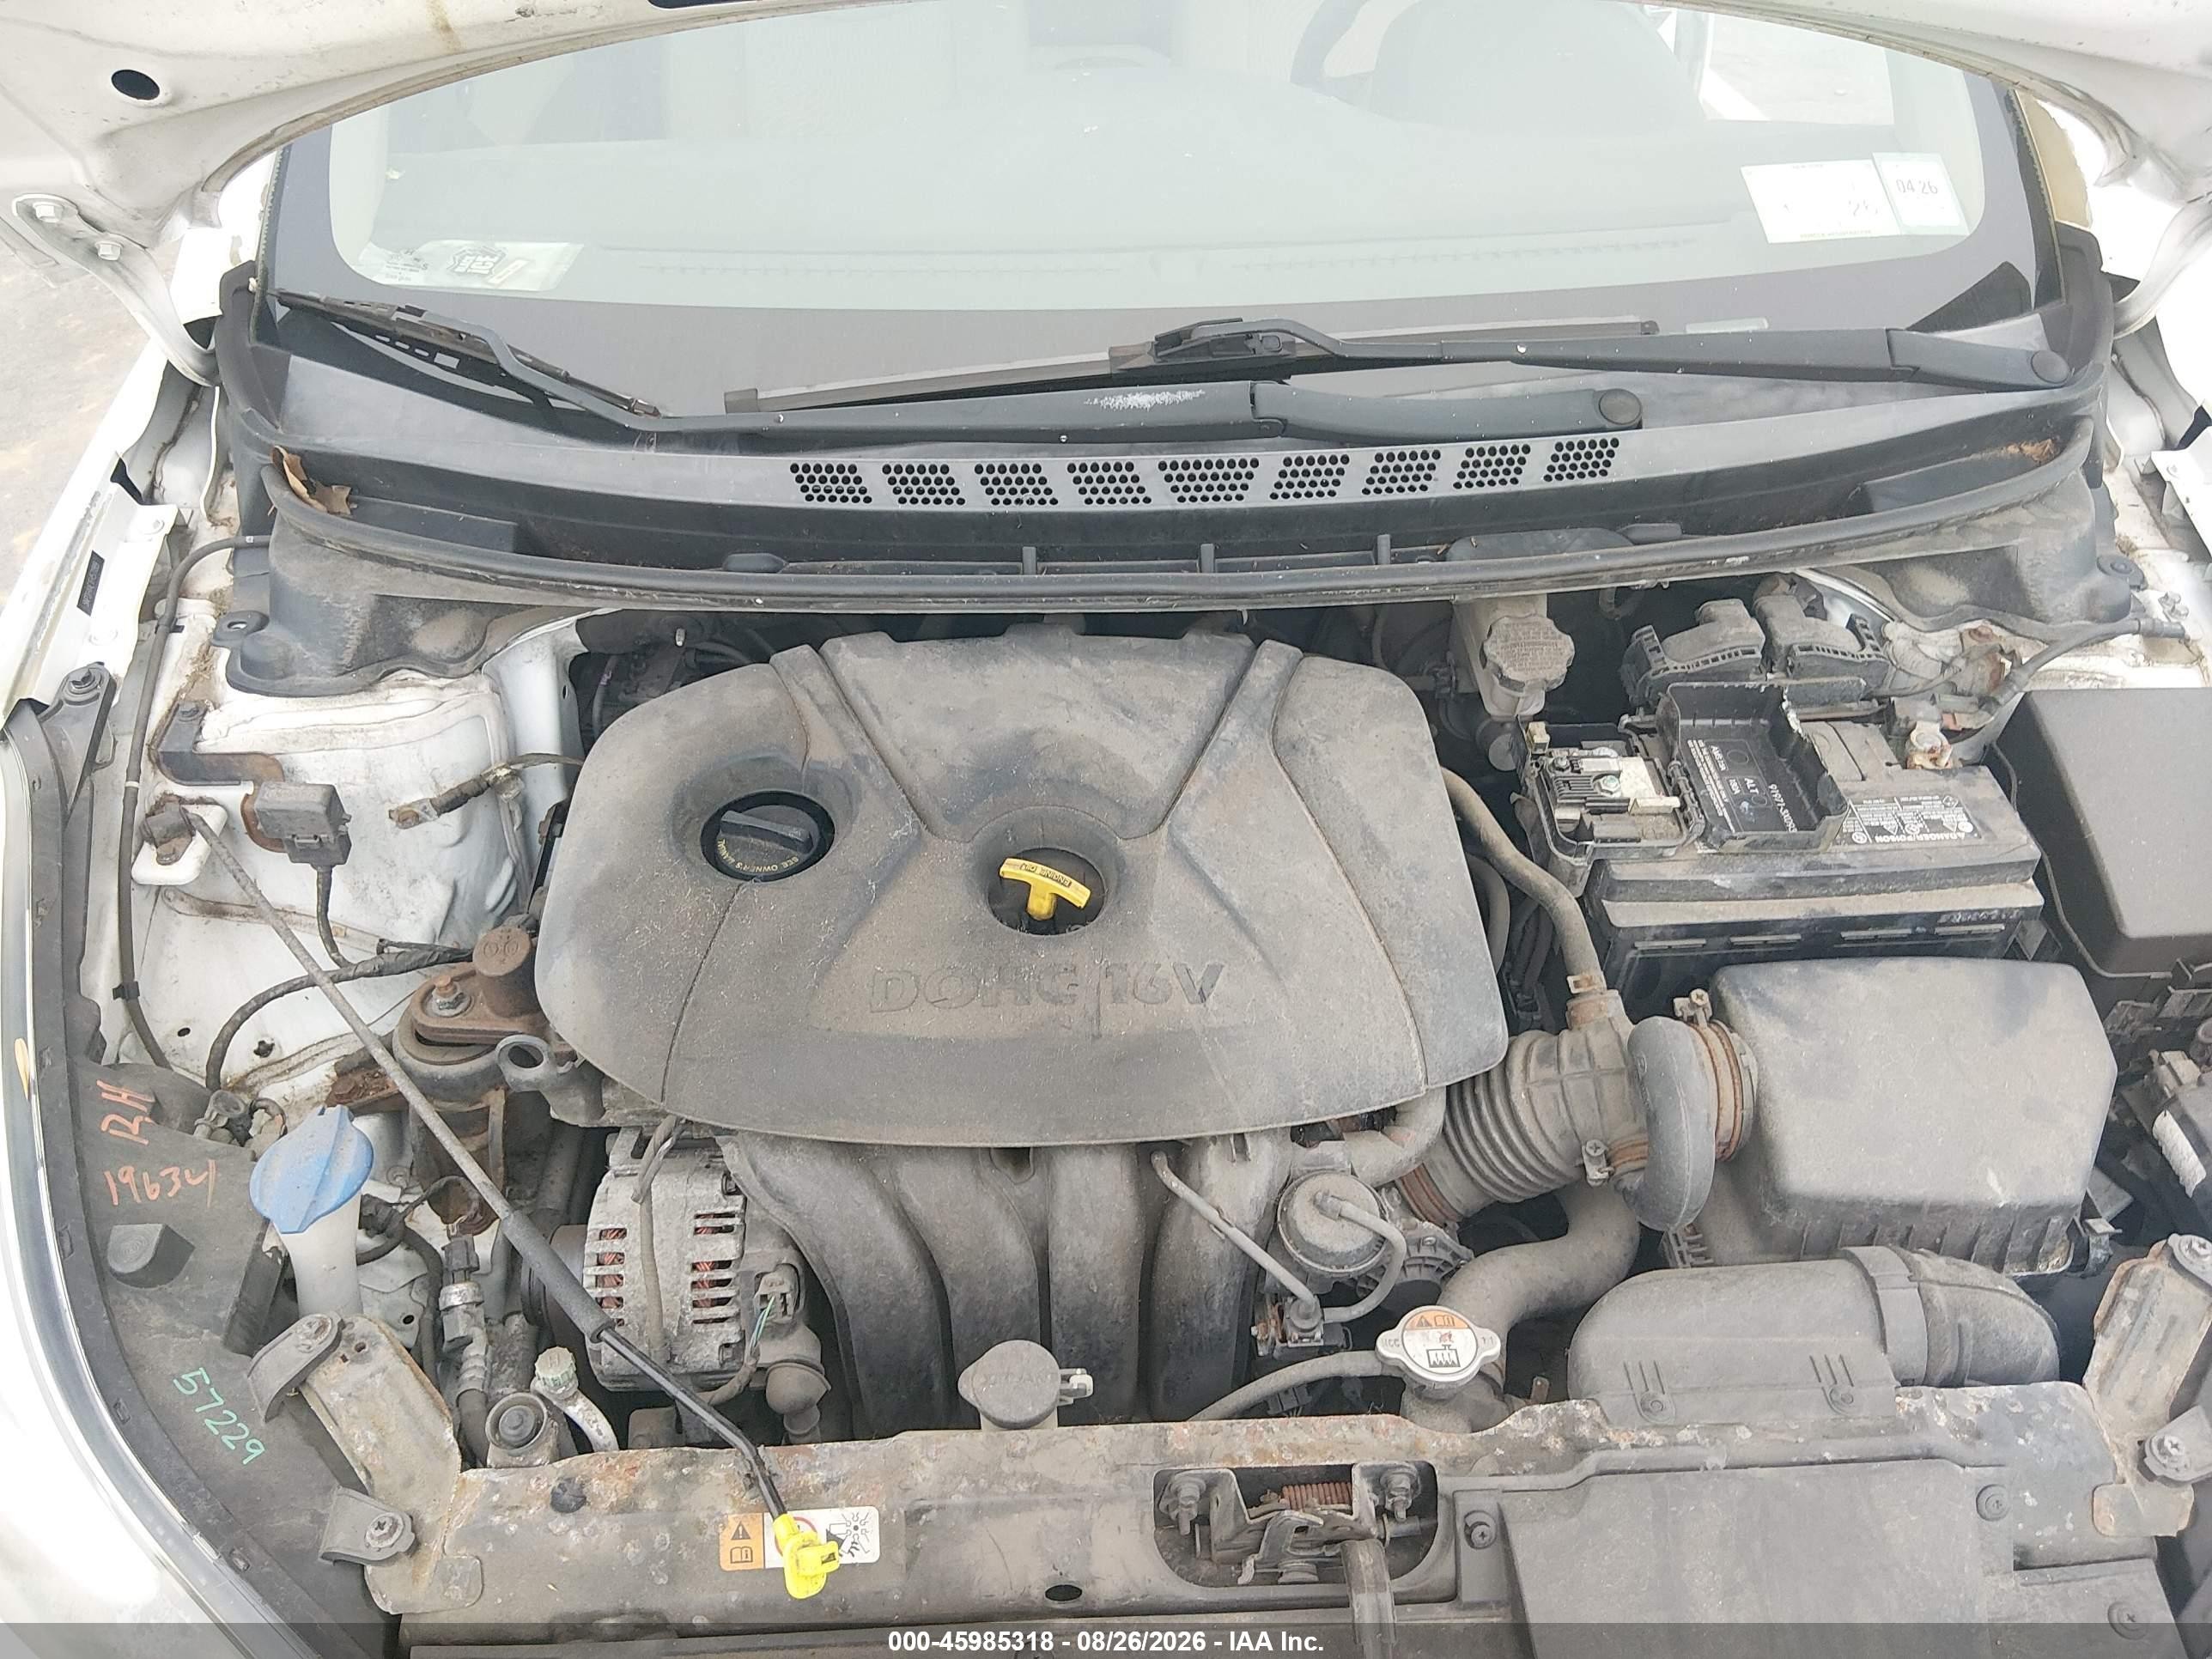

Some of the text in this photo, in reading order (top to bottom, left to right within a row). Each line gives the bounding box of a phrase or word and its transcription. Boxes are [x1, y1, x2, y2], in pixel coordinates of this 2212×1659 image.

[1744, 777, 1759, 795] ALT
[735, 861, 779, 873] OWNER'S
[782, 856, 799, 869] SEE
[1019, 862, 1073, 888] ENGINE OIL
[869, 961, 1225, 1013] DOHC 16V
[103, 1159, 217, 1208] 19634
[173, 1366, 266, 1466] 57229
